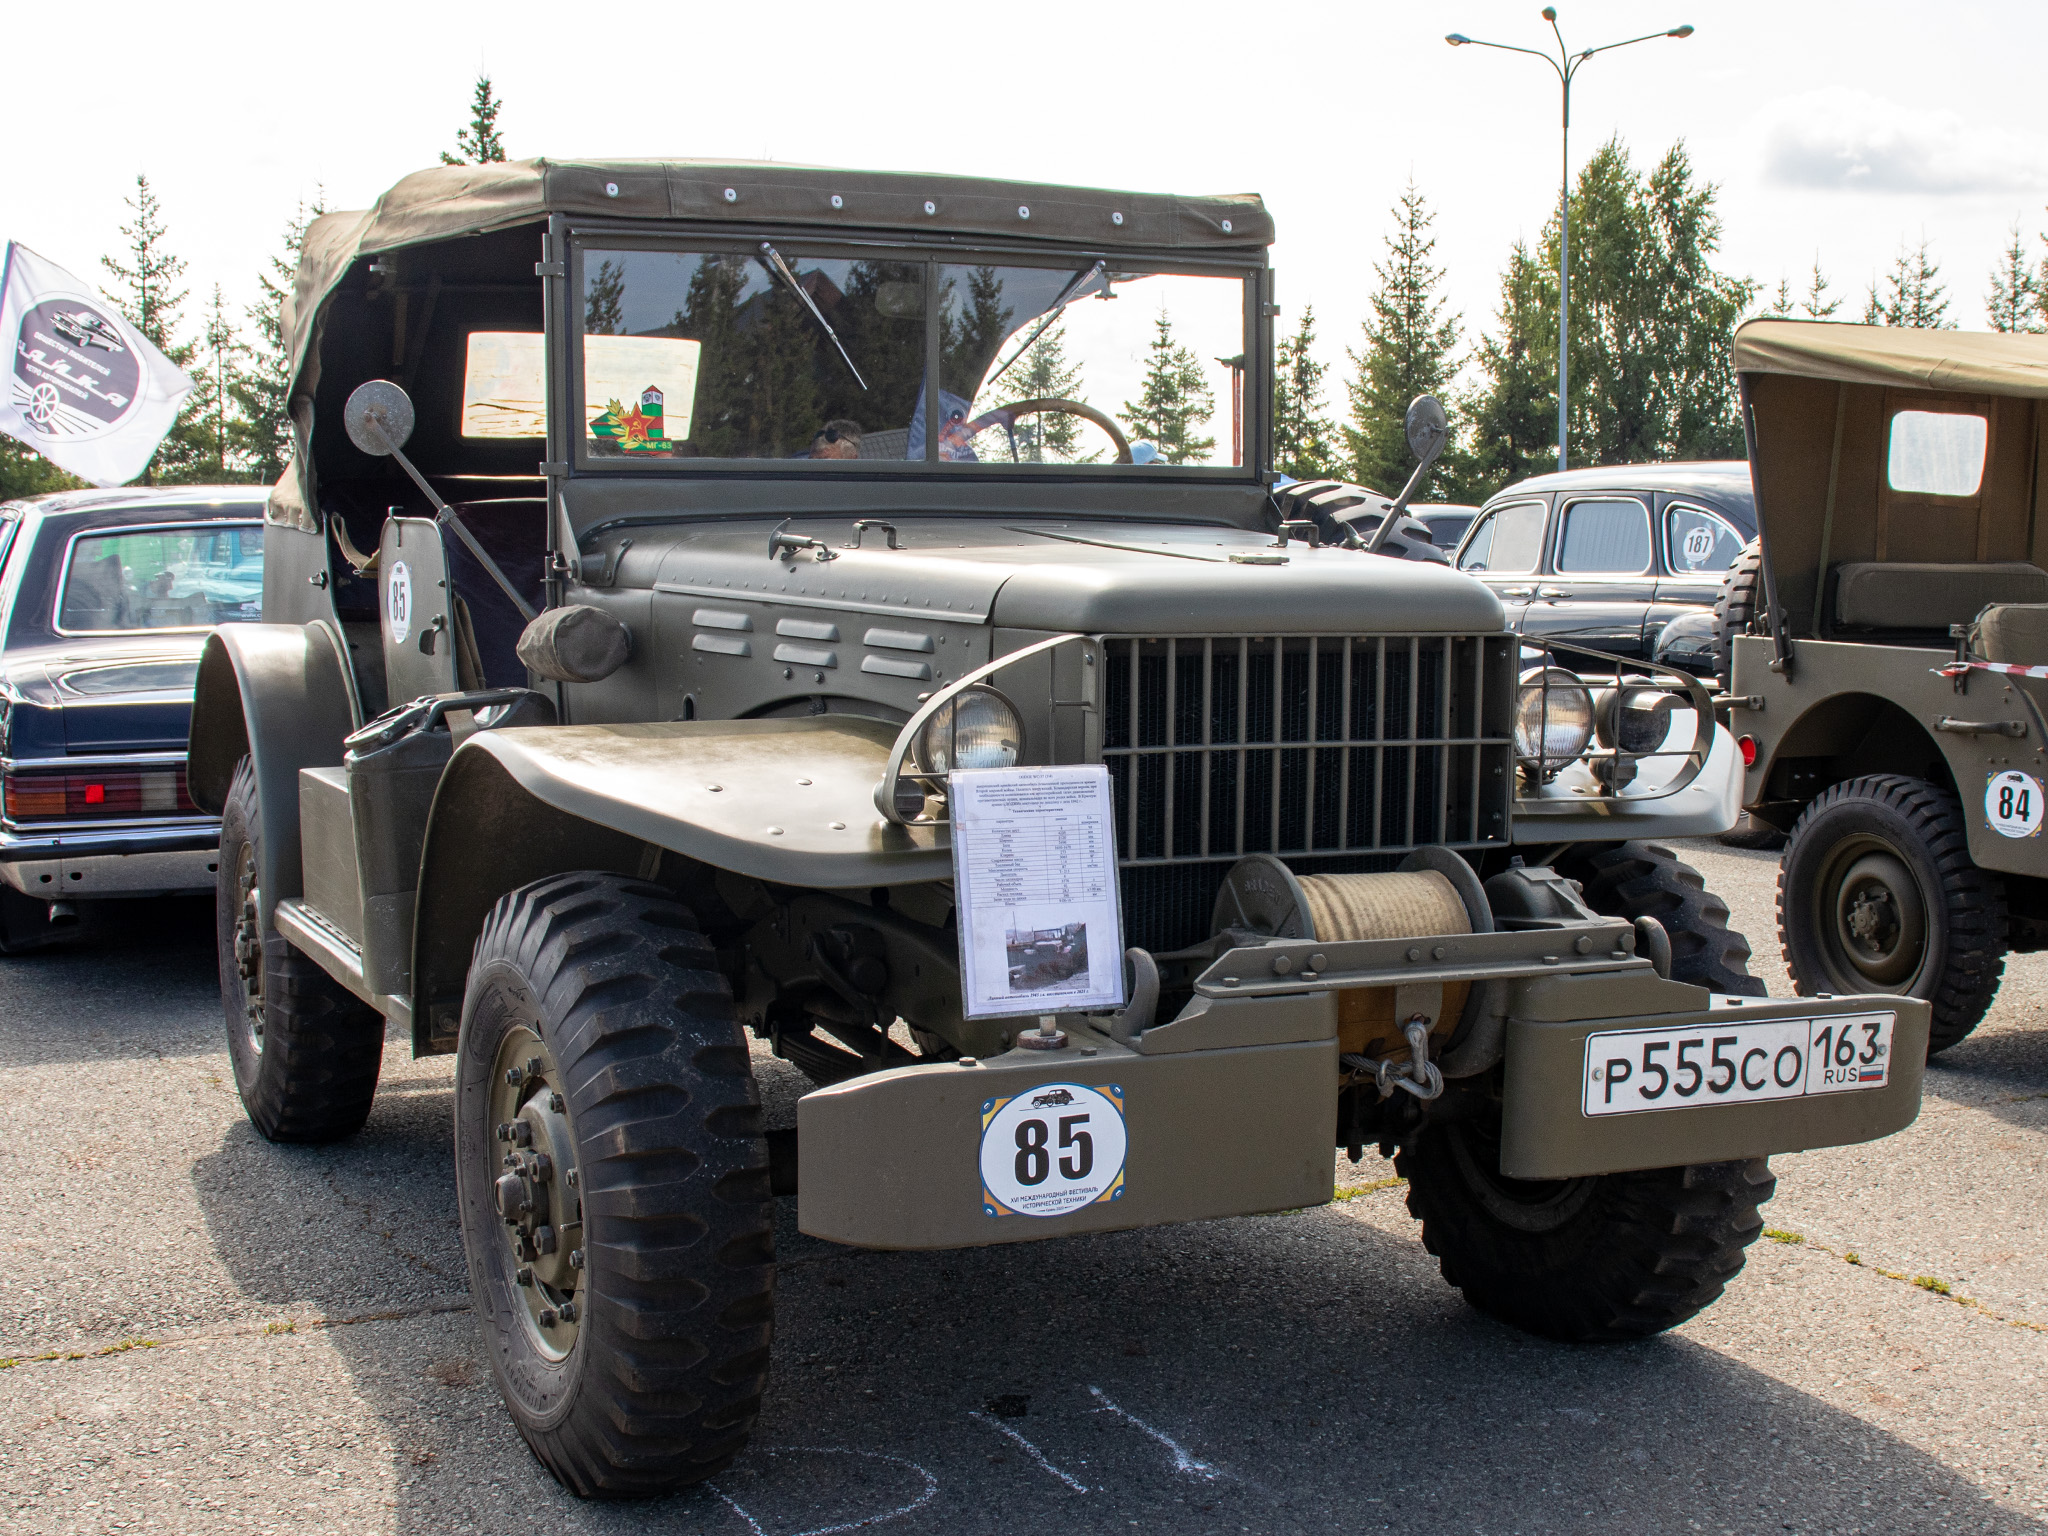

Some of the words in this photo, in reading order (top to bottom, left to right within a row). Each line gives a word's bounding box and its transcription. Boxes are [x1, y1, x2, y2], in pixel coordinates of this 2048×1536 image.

[34, 331, 69, 354] ОБЩЕСТВО
[68, 349, 111, 376] ЛЮБИТЕЛЕЙ
[1688, 535, 1710, 553] 187
[393, 580, 406, 622] 85
[1999, 786, 2030, 822] 84
[1813, 1022, 1881, 1069] 163
[1823, 1066, 1858, 1085] RUS
[1014, 1113, 1094, 1186] 85
[1020, 1189, 1068, 1202] МЕЖДУНАРОДНЫЙ
[1068, 1186, 1099, 1195] ФЕСТИВАЛЬ
[1022, 1198, 1062, 1209] ИСТОРИЧЕСКОЙ
[1063, 1195, 1087, 1204] ТЕХНИКИ
